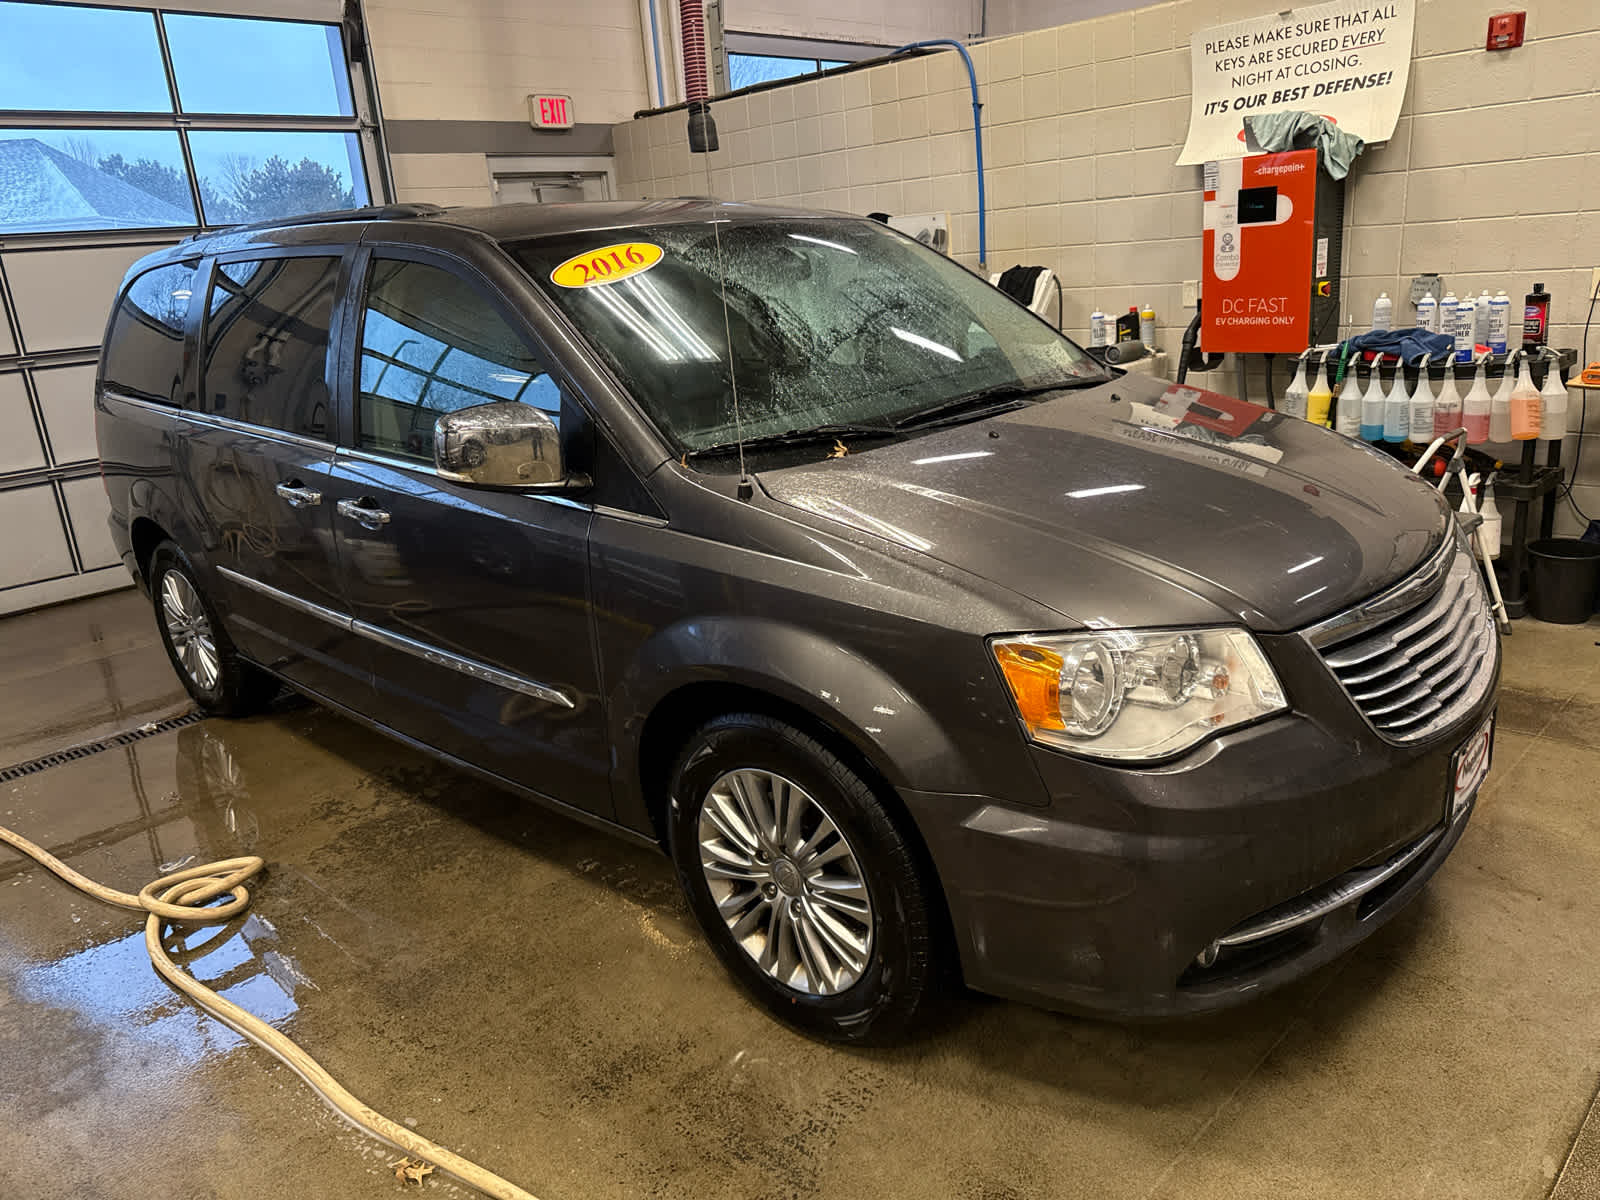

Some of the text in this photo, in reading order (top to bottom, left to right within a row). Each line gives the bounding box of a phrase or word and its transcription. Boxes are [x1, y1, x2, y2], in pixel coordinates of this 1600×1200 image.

[1205, 4, 1398, 55] PLEASE MAKE SURE THAT ALL
[1215, 28, 1386, 73] KEYS ARE SECURED EVERY
[1231, 54, 1363, 89] NIGHT AT CLOSING.
[539, 98, 568, 125] EXIT
[1204, 71, 1393, 116] IT'S OUR BEST DEFENSE!
[574, 246, 644, 284] 2016
[1215, 316, 1295, 326] EV CHARGING ONLY
[1222, 297, 1289, 314] DC FAST
